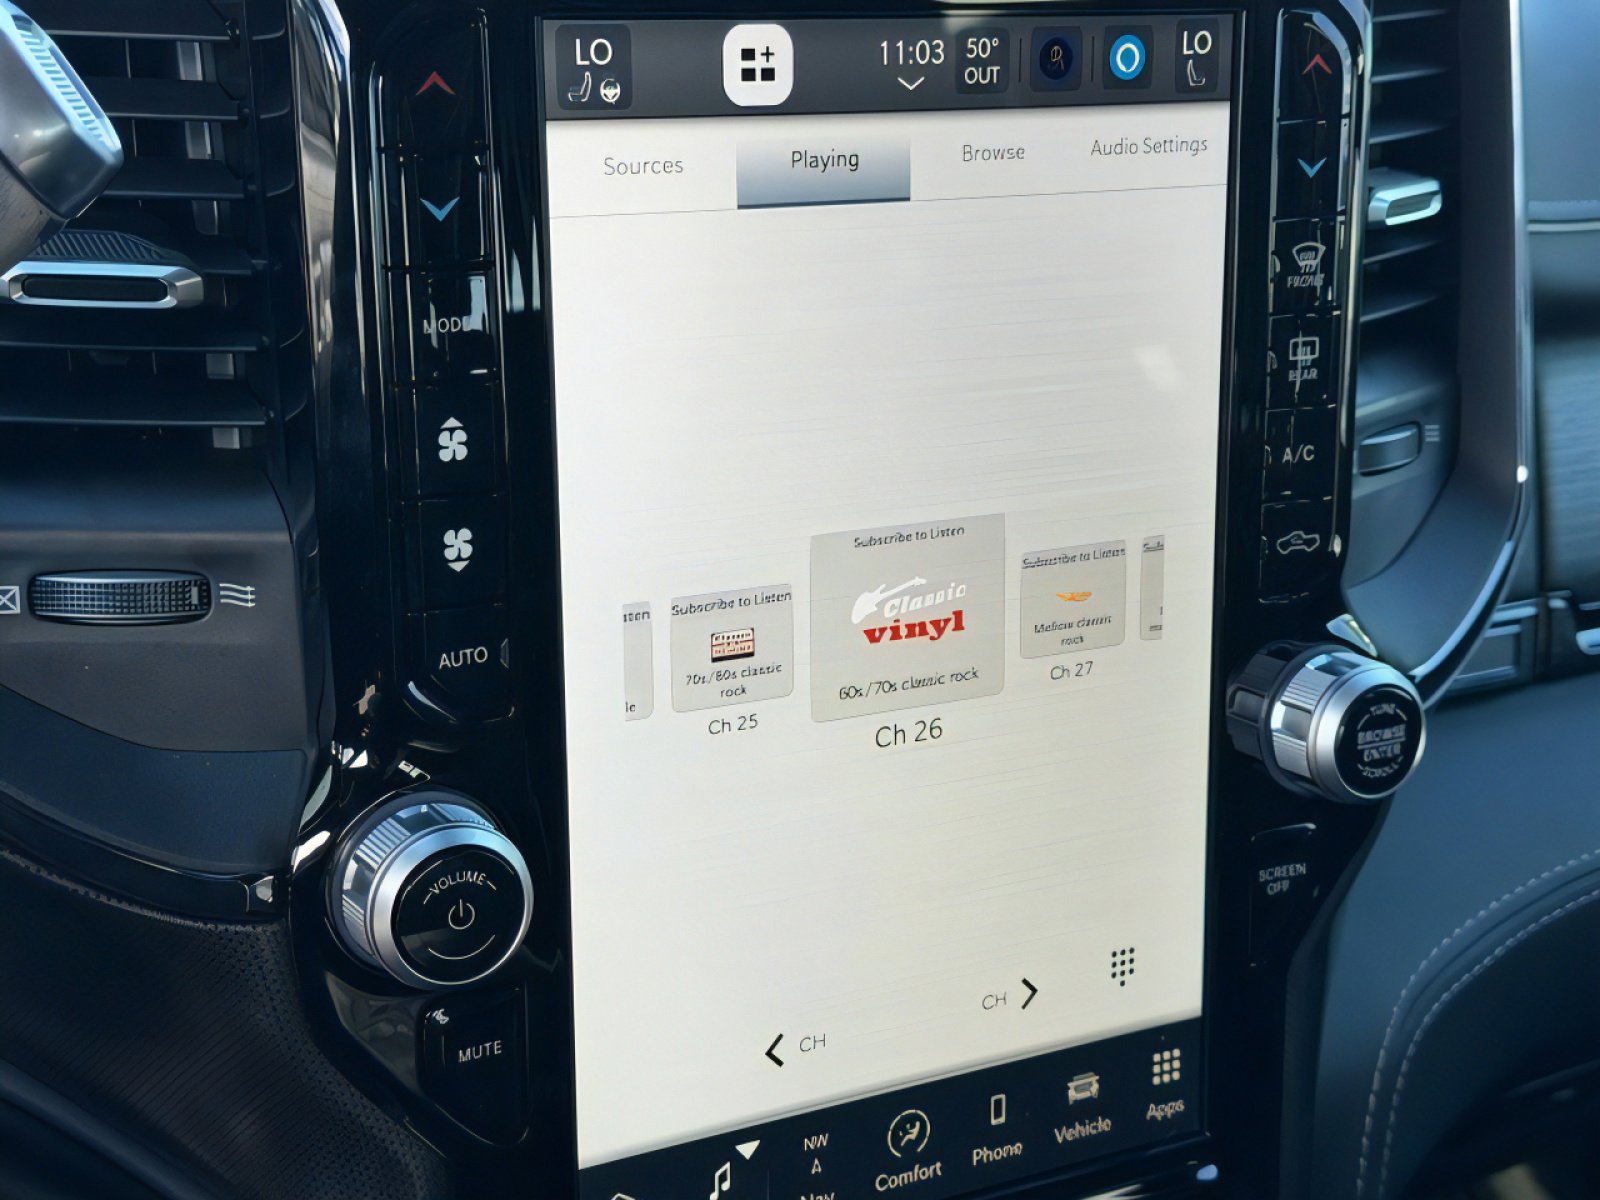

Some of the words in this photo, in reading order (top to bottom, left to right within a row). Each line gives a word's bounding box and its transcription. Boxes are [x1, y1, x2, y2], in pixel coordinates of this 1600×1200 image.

[575, 38, 613, 66] LO
[880, 39, 945, 65] 11:03
[1183, 30, 1212, 56] LO
[965, 66, 1000, 84] OUT
[962, 143, 1025, 162] Browse
[1091, 138, 1138, 157] Audio
[1143, 135, 1208, 156] Settings
[604, 156, 684, 176] Sources
[791, 148, 859, 173] Playing
[1282, 445, 1315, 464] A/C
[854, 533, 912, 548] Subscribe
[915, 530, 927, 541] to
[671, 597, 736, 616] Subscribe
[738, 596, 752, 607] to
[863, 609, 965, 644] vinyl
[438, 645, 489, 669] AUTO
[950, 666, 980, 682] rock
[1050, 664, 1071, 681] Ch
[1074, 660, 1094, 677] 27
[720, 685, 747, 698] rock
[708, 718, 732, 735] Ch
[737, 713, 759, 731] 25
[875, 723, 907, 748] Ch
[914, 717, 944, 743] 26
[429, 870, 487, 894] VOLUME
[981, 992, 1007, 1010] CH
[459, 1040, 502, 1063] MUTE
[799, 1033, 826, 1052] CH
[1055, 1115, 1111, 1144] Vehicle
[972, 1141, 1023, 1166] Phone
[875, 1161, 942, 1192] Comfort
